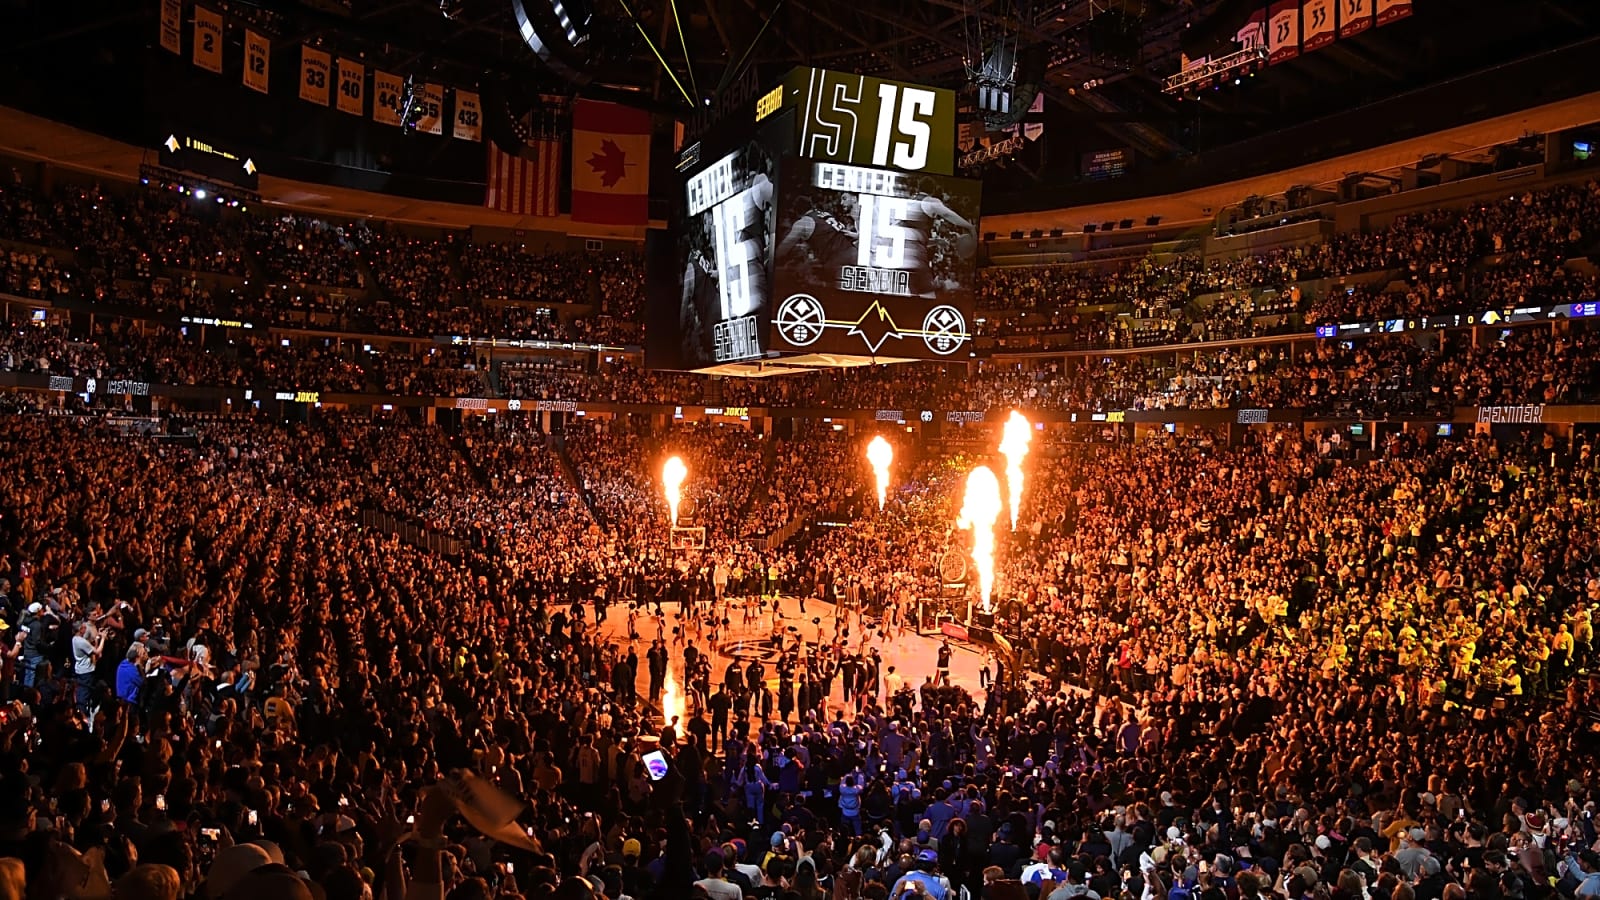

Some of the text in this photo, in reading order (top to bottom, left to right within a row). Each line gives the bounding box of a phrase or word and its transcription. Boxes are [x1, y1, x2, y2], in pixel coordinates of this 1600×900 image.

[203, 33, 214, 53] 2
[249, 54, 265, 75] 12
[306, 68, 325, 89] 33
[341, 80, 360, 99] 40
[379, 91, 397, 109] 44
[755, 83, 784, 123] SERBIA
[458, 109, 478, 127] 432
[871, 83, 936, 170] 15
[858, 194, 907, 269] 15
[841, 266, 909, 294] SERBIA
[714, 315, 760, 362] SERBIA
[1236, 408, 1269, 424] SERBIA
